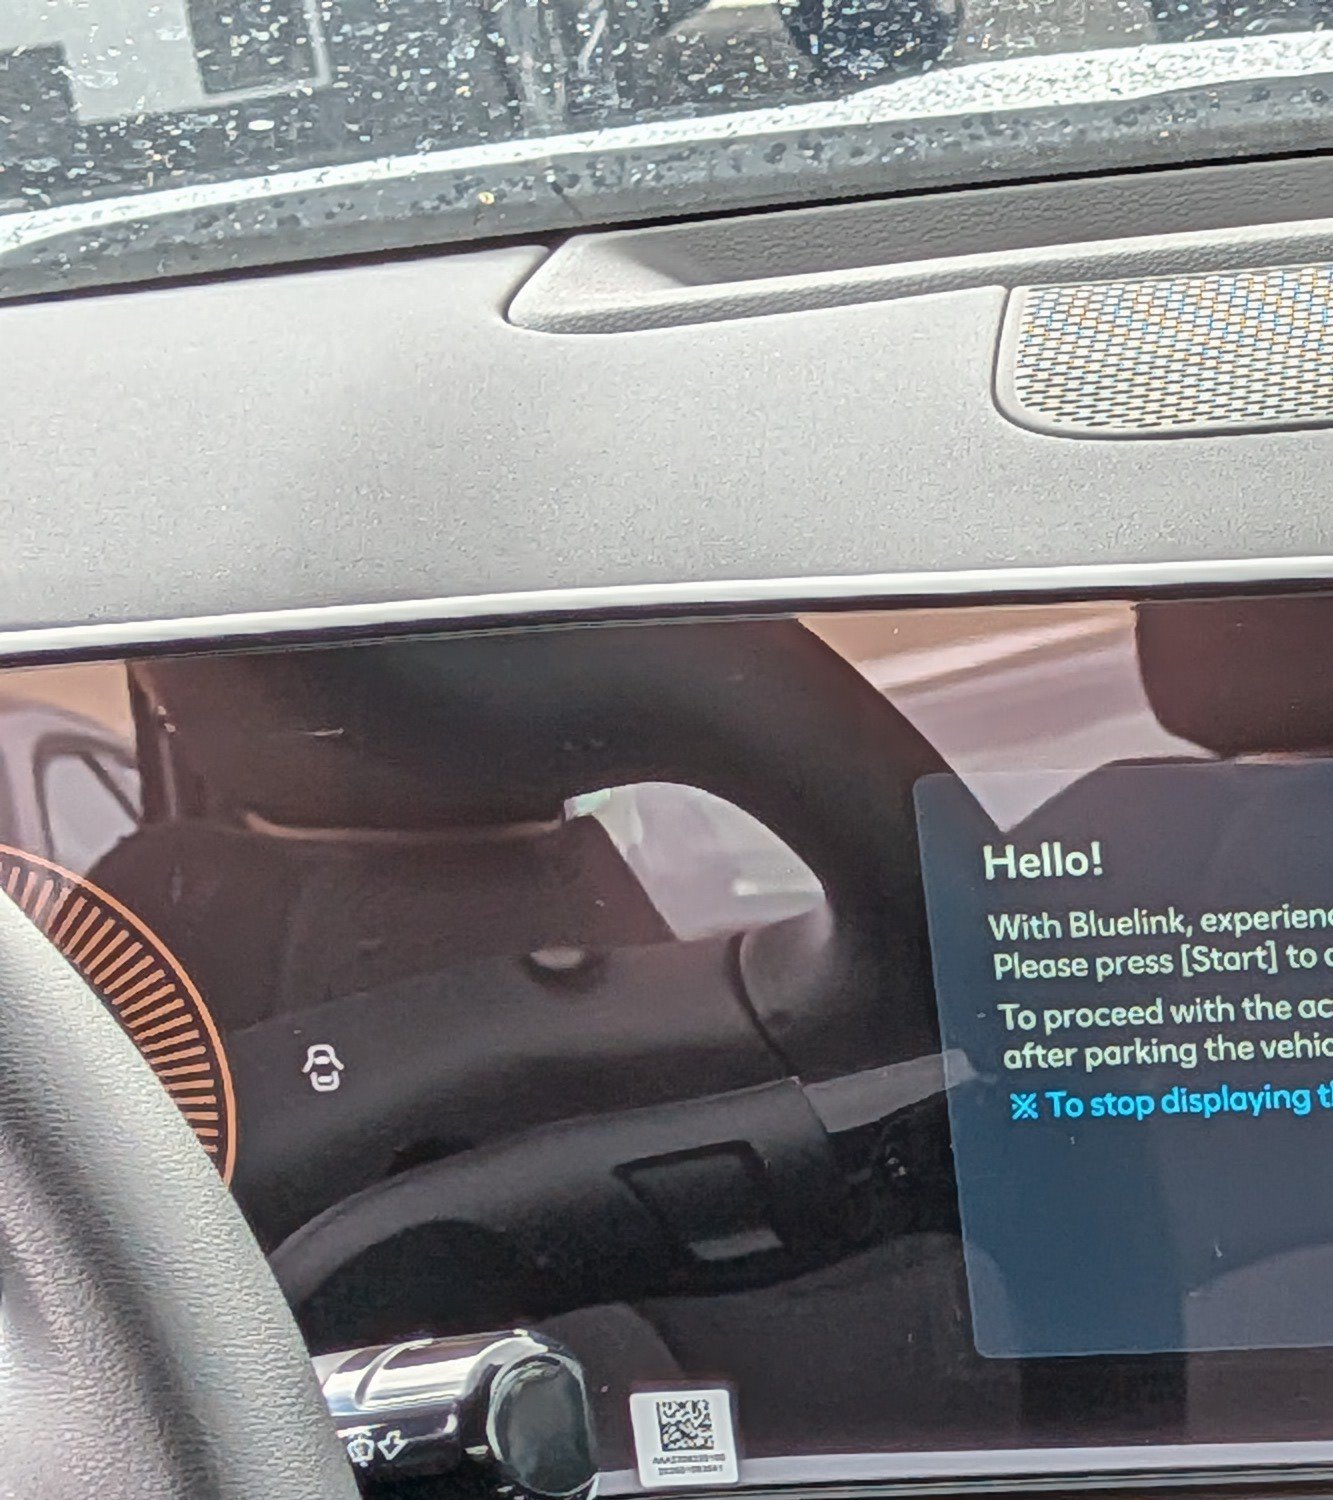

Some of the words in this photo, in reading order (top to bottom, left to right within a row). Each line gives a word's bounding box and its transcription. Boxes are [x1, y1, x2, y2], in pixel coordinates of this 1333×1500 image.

[984, 842, 1102, 880] Hello!
[988, 912, 1062, 940] With
[1069, 907, 1192, 938] Bluelink,
[994, 952, 1088, 980] Please
[1096, 954, 1173, 982] press
[1181, 940, 1278, 976] [Start]
[1286, 945, 1317, 968] to
[997, 1004, 1036, 1030] To
[1044, 998, 1163, 1035] proceed
[1170, 996, 1234, 1023] with
[1242, 994, 1292, 1020] the
[1004, 1042, 1077, 1069] after
[1085, 1038, 1197, 1072] parking
[1204, 1034, 1254, 1061] the
[1045, 1091, 1084, 1117] To
[1091, 1093, 1155, 1120] stop
[1161, 1084, 1311, 1118] displaying
